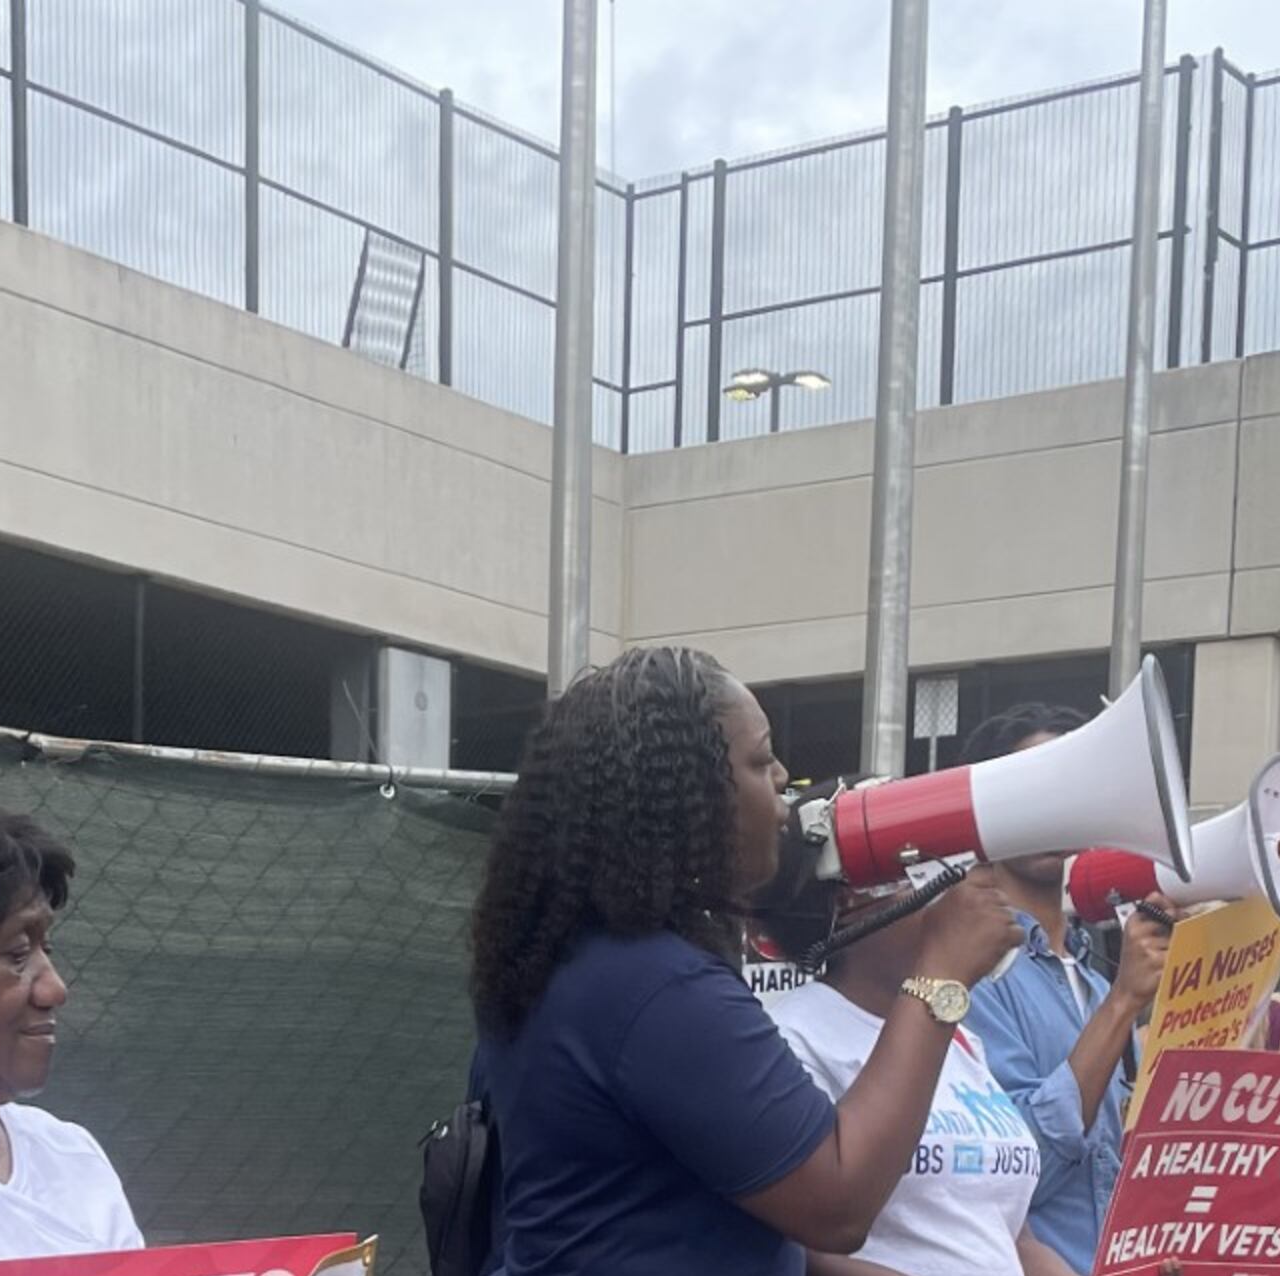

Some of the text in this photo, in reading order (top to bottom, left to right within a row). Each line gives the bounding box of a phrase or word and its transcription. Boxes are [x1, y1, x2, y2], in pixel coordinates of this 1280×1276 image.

[1168, 929, 1279, 999] VA Nurses
[1158, 983, 1253, 1038] Protecting
[1160, 1071, 1222, 1122] NO
[1131, 1144, 1152, 1179] A
[1153, 1141, 1278, 1177] HEALTHY
[1105, 1222, 1215, 1265] HEALTHY
